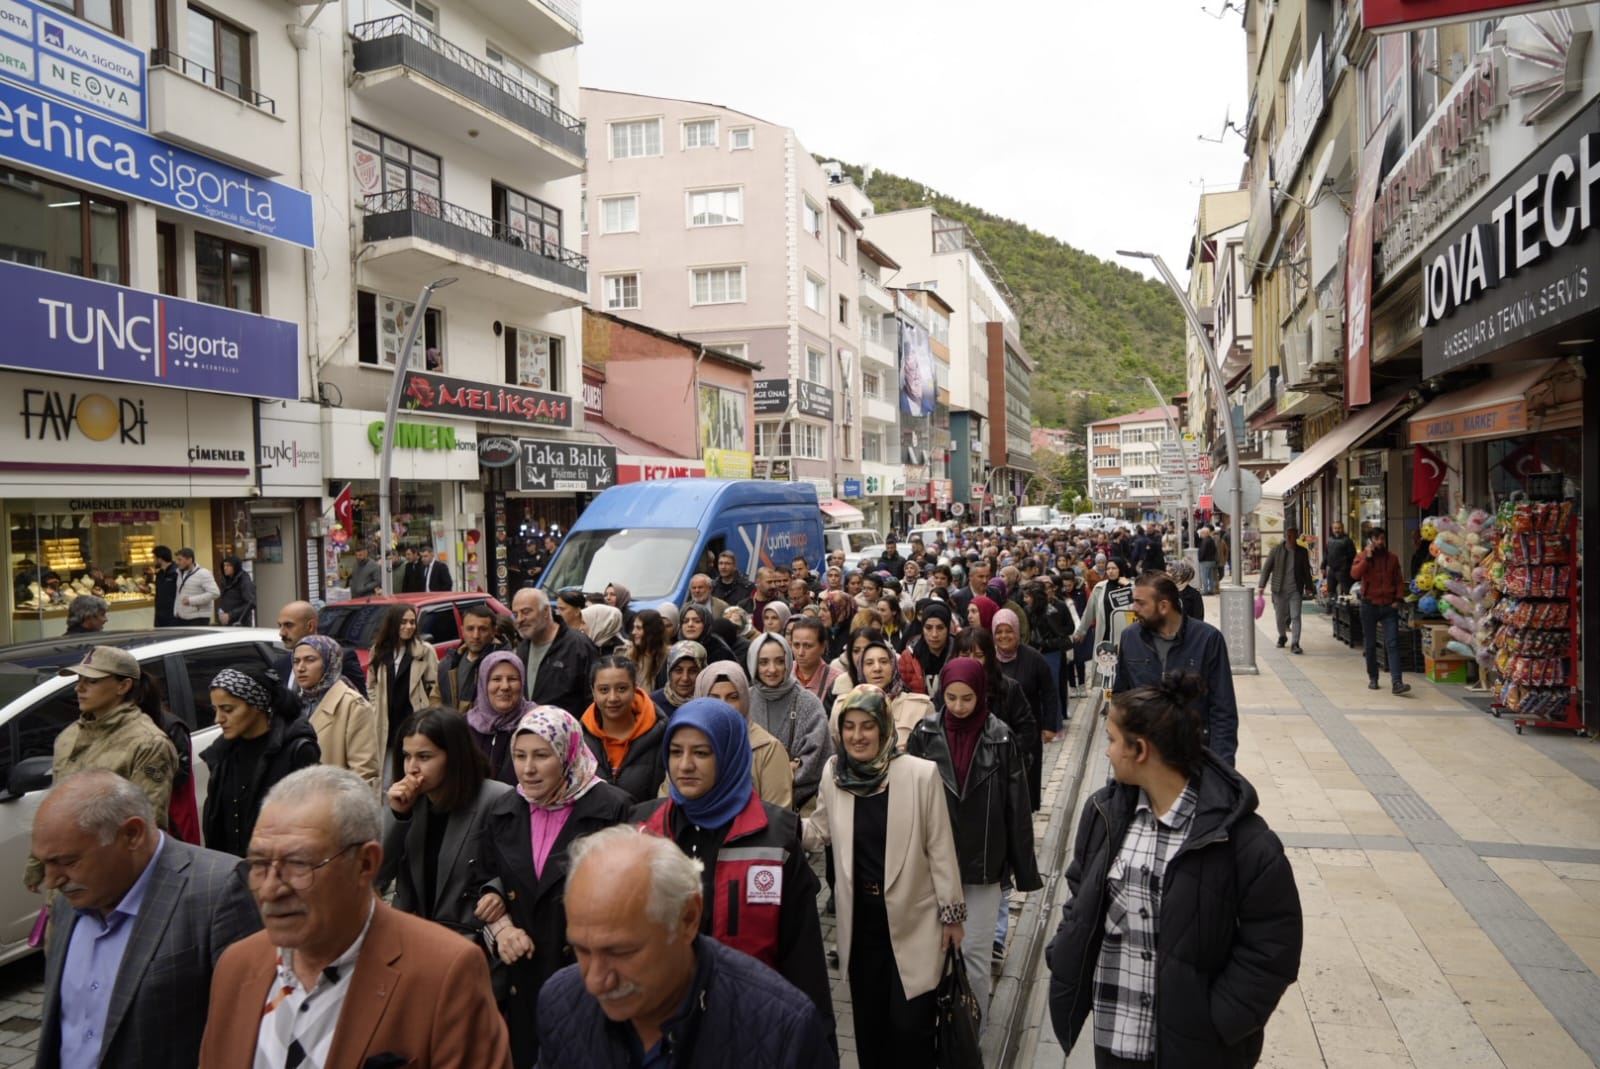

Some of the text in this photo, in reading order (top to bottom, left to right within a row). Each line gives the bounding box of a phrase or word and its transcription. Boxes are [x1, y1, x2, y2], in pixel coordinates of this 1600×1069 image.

[66, 44, 89, 60] AXA
[52, 63, 129, 106] NEOVA
[149, 150, 276, 222] sigorta
[1443, 263, 1589, 360] AKSESUAR & TEKNİK SERVİS
[38, 291, 152, 370] TUNÇ
[168, 326, 239, 360] sigorta
[438, 383, 567, 420] MELİKŞAH
[1462, 411, 1499, 432] MARKET
[188, 445, 246, 463] ÇİMENLER
[261, 440, 292, 467] TUNÇ
[455, 439, 477, 451] Home
[524, 443, 565, 465] Taka
[568, 446, 607, 467] Balık
[645, 464, 690, 480] ECZANE
